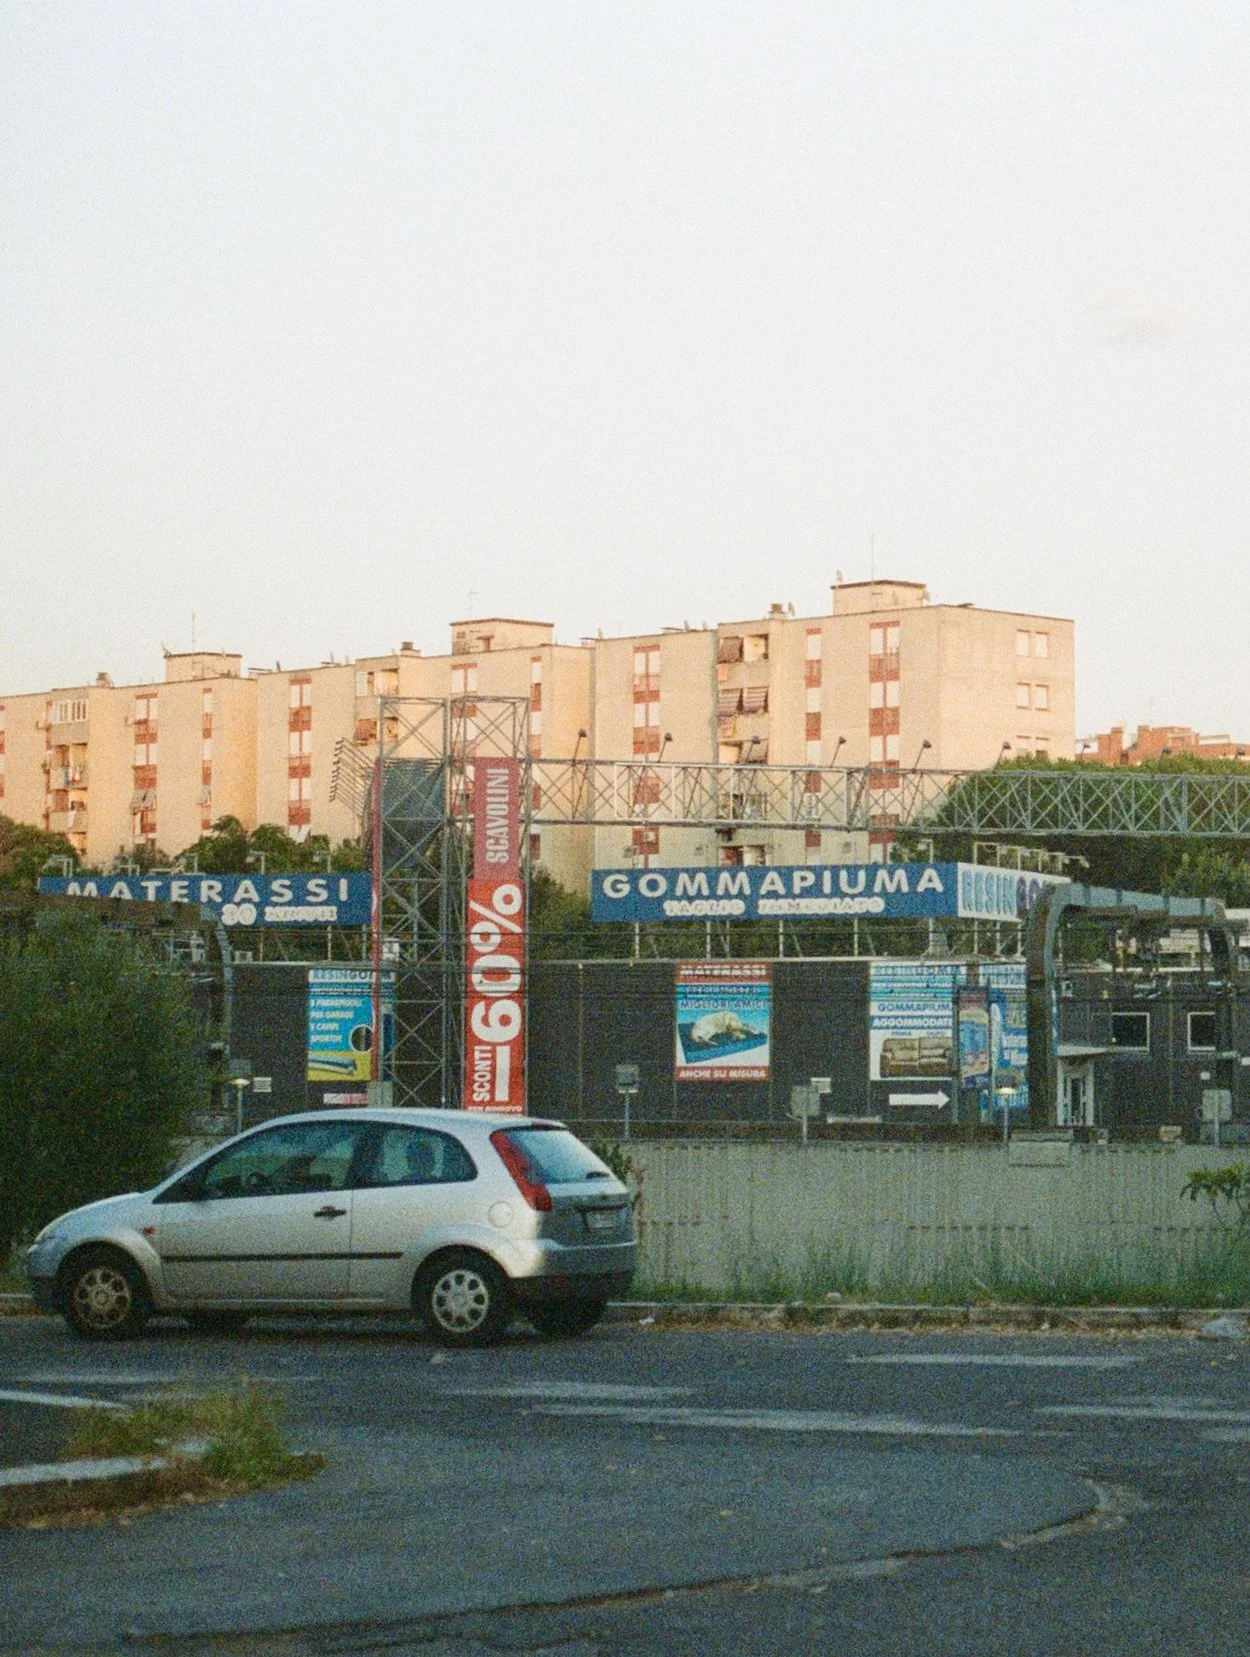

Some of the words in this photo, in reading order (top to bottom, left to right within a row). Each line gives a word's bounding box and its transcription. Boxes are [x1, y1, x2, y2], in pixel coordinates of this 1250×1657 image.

[486, 767, 510, 864] SCAVOLINI
[67, 878, 349, 903] MATERASSI
[603, 869, 944, 899] GOMMAPIUMA
[962, 871, 1040, 915] RESINGO
[664, 900, 745, 916] TAGLIO
[878, 1002, 952, 1012] GOMMAPIUM
[472, 1045, 492, 1102] SCONTI
